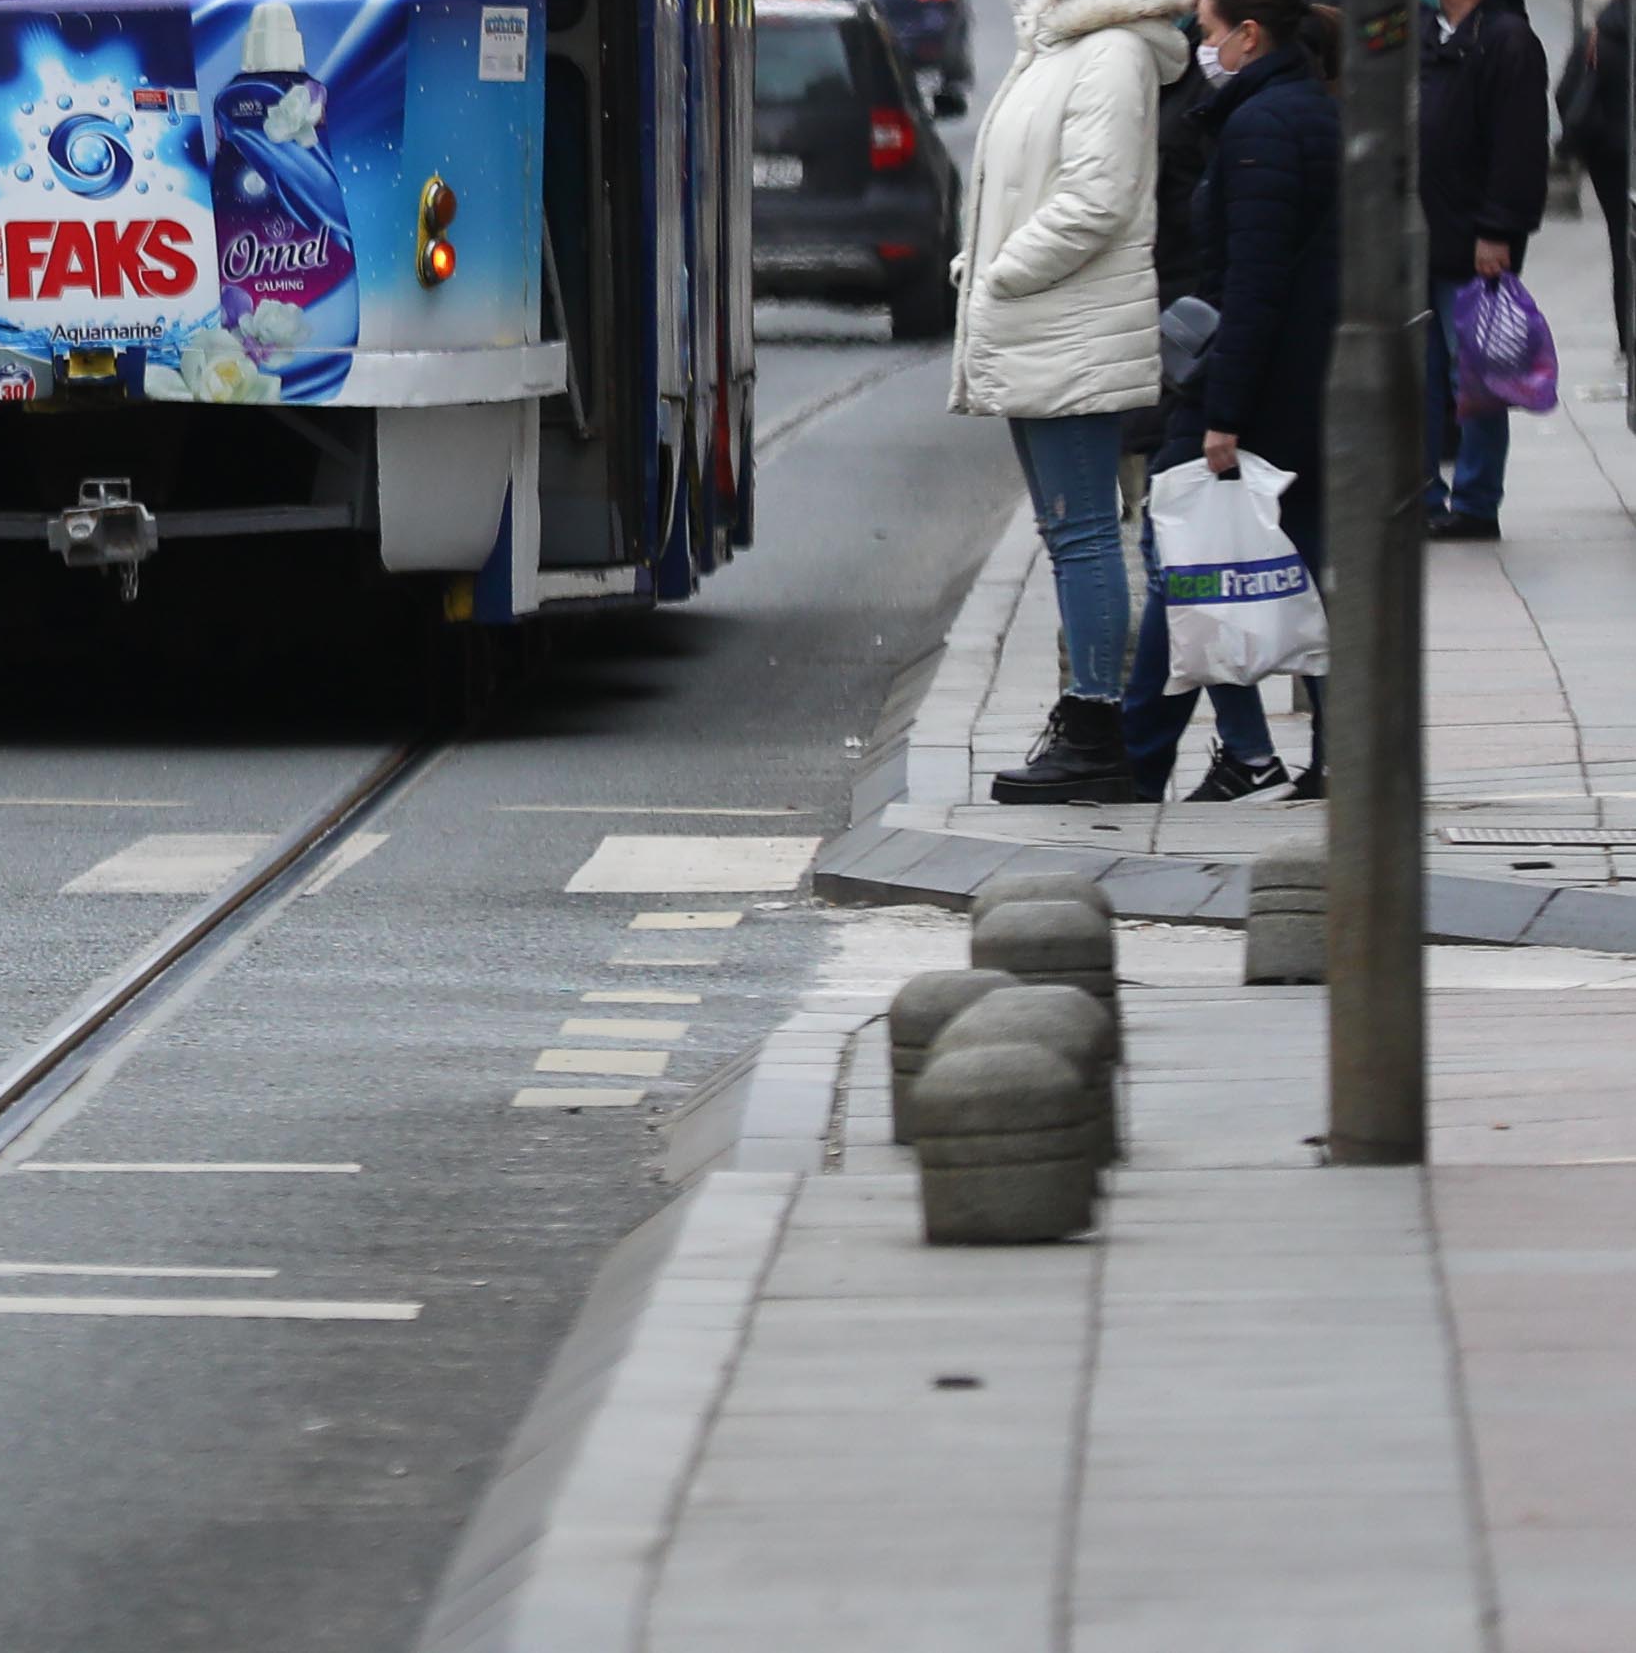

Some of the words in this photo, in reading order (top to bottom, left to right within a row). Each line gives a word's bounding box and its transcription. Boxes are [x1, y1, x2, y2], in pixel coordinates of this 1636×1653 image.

[3, 219, 199, 301] FAKS
[222, 225, 329, 282] Ornel
[253, 277, 306, 293] CALMING
[52, 321, 163, 344] Aquamarine
